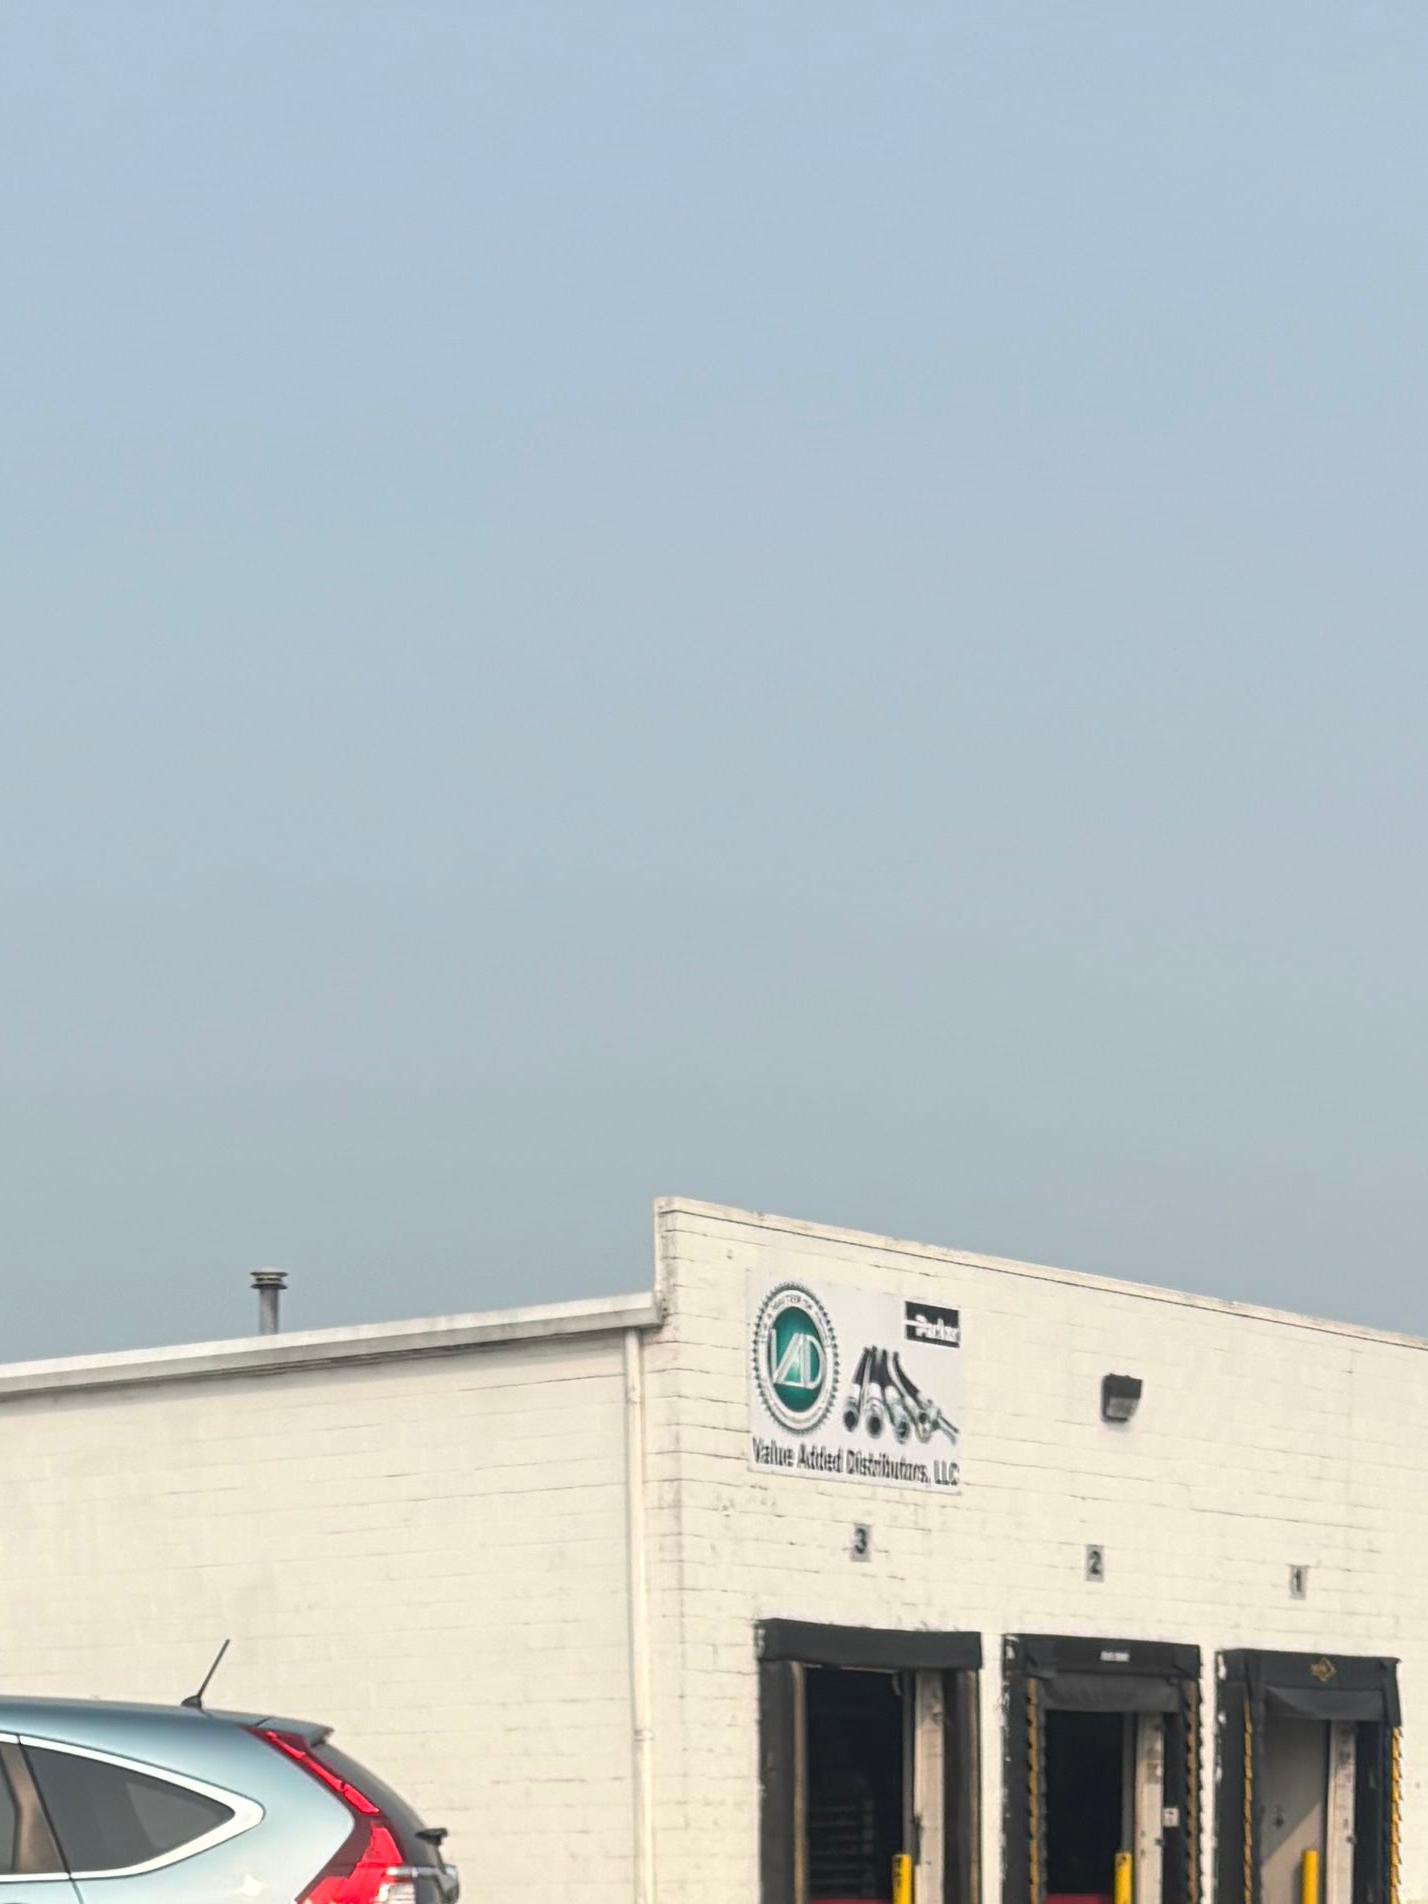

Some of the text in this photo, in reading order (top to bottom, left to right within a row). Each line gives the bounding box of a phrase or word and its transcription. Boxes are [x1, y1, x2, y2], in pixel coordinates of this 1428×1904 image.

[753, 1436, 794, 1468] Value
[796, 1443, 842, 1474] Added
[933, 1460, 960, 1486] LLC
[854, 1527, 868, 1555] 3
[1088, 1550, 1102, 1576] 2
